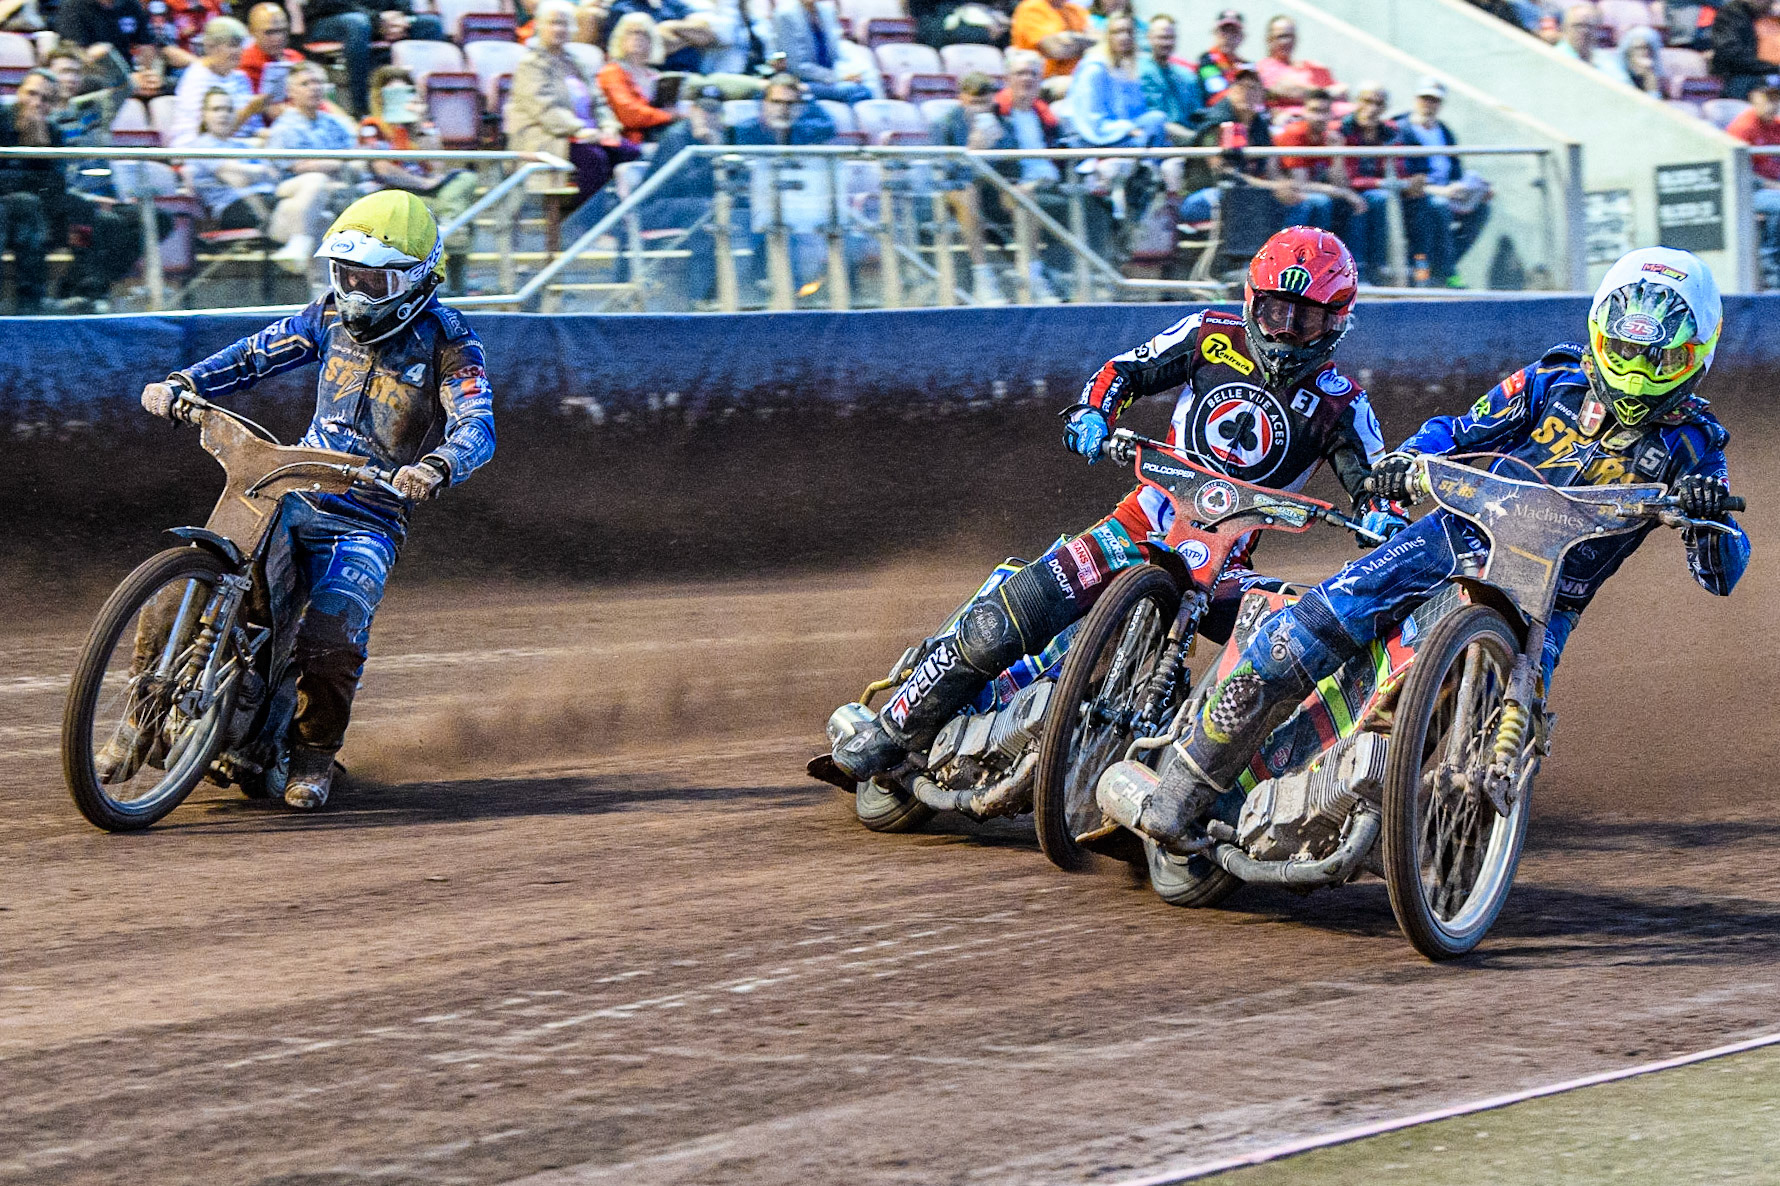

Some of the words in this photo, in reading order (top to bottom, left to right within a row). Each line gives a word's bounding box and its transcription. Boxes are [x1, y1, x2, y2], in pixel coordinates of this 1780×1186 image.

[1621, 321, 1657, 334] STS
[1206, 338, 1250, 372] Rentruck
[406, 363, 426, 381] 4
[1295, 391, 1314, 413] 3
[1552, 401, 1578, 421] KING'S
[1207, 388, 1243, 409] BELLE
[1248, 391, 1273, 411] VUE
[1269, 414, 1285, 446] ACES
[1142, 462, 1196, 479] POLCOPPER
[1638, 447, 1665, 471] 5
[1513, 503, 1584, 529] MacInnes
[1182, 548, 1204, 561] ATPI
[1360, 535, 1427, 575] MacInnes
[1048, 558, 1076, 599] DOCUFY
